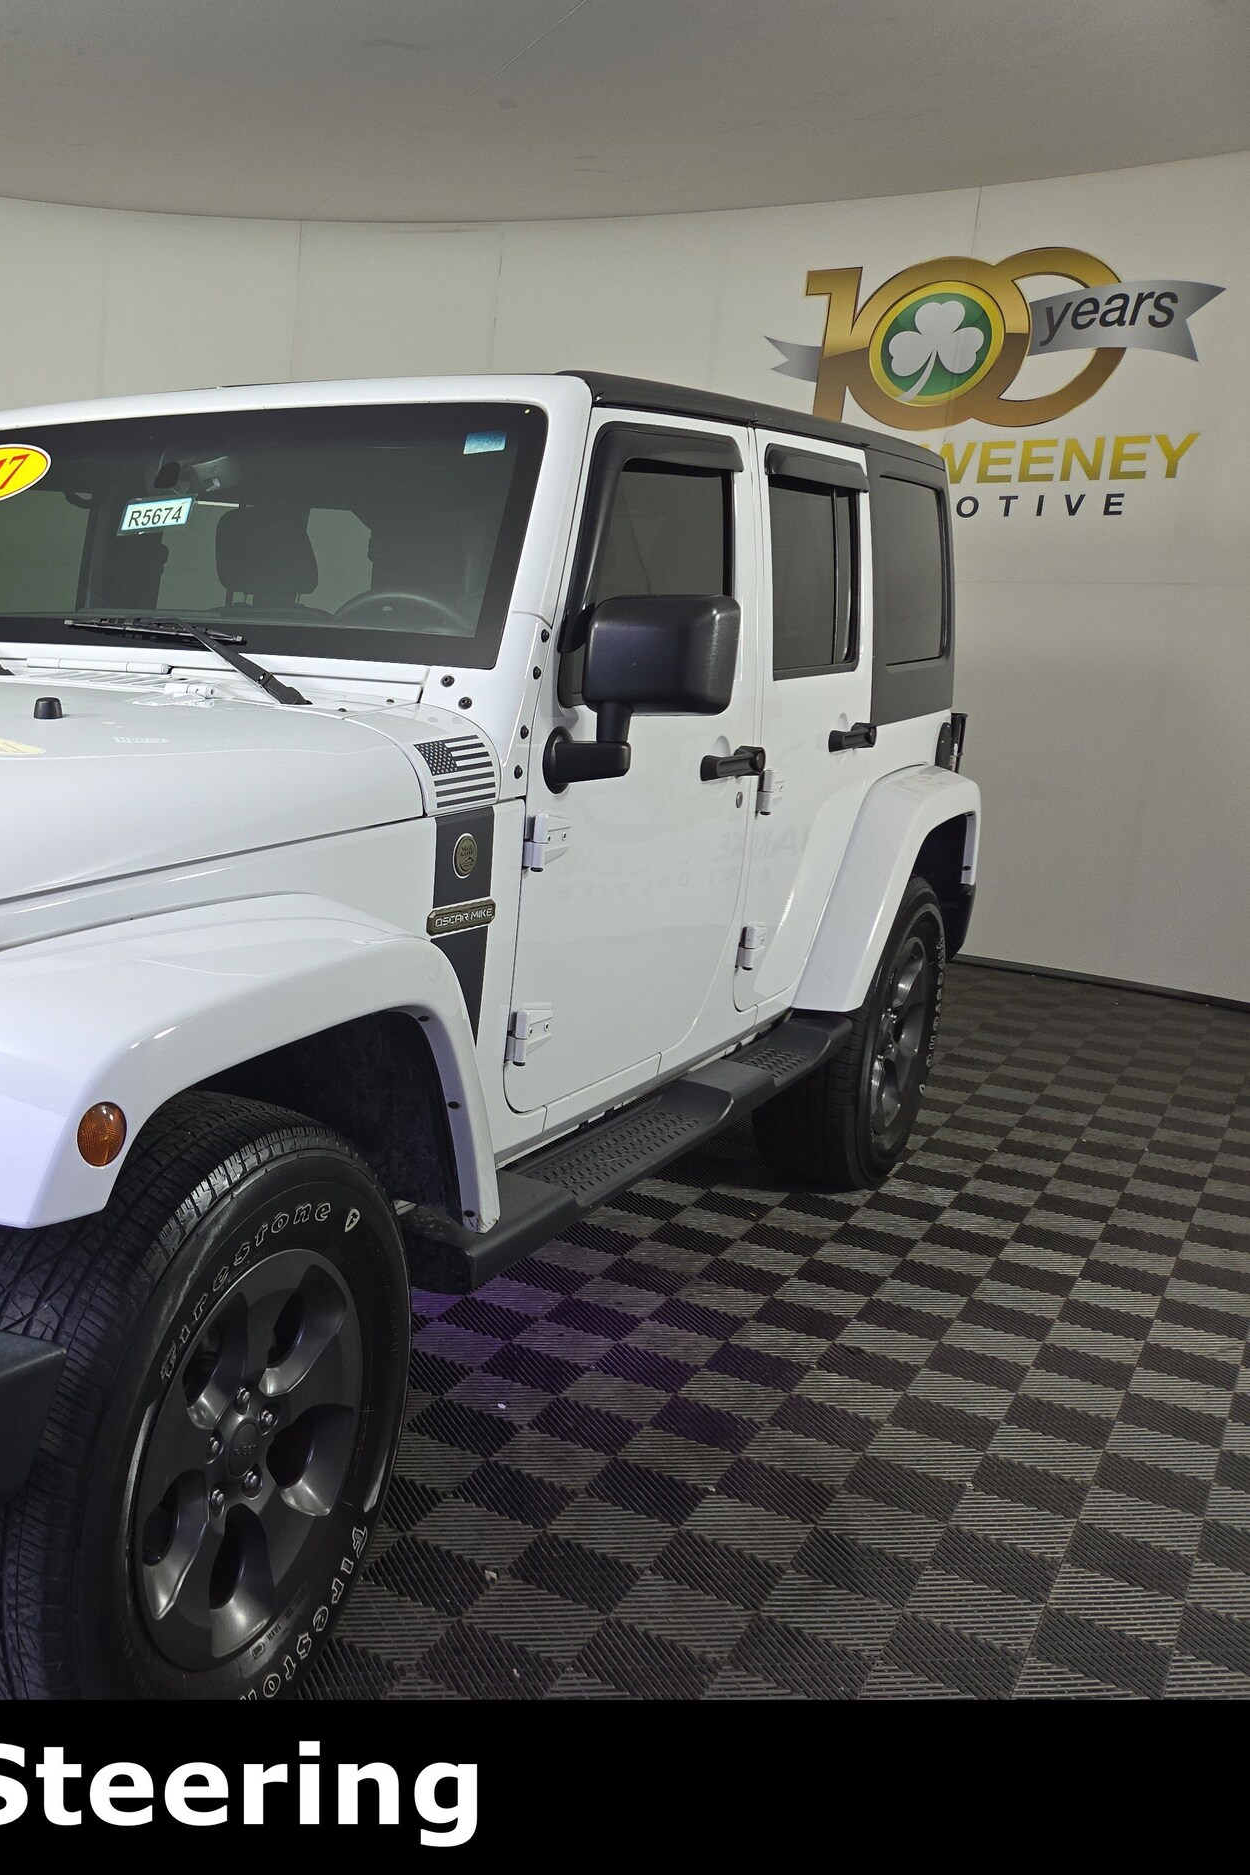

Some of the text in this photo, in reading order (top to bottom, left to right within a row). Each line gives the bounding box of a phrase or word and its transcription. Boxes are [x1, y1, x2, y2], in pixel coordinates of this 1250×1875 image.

[806, 247, 1180, 431] 100 years
[919, 432, 1202, 484] WEENEY
[127, 505, 183, 528] R5674
[434, 907, 493, 927] OSCAR MIKE
[160, 1202, 332, 1381] Firestone
